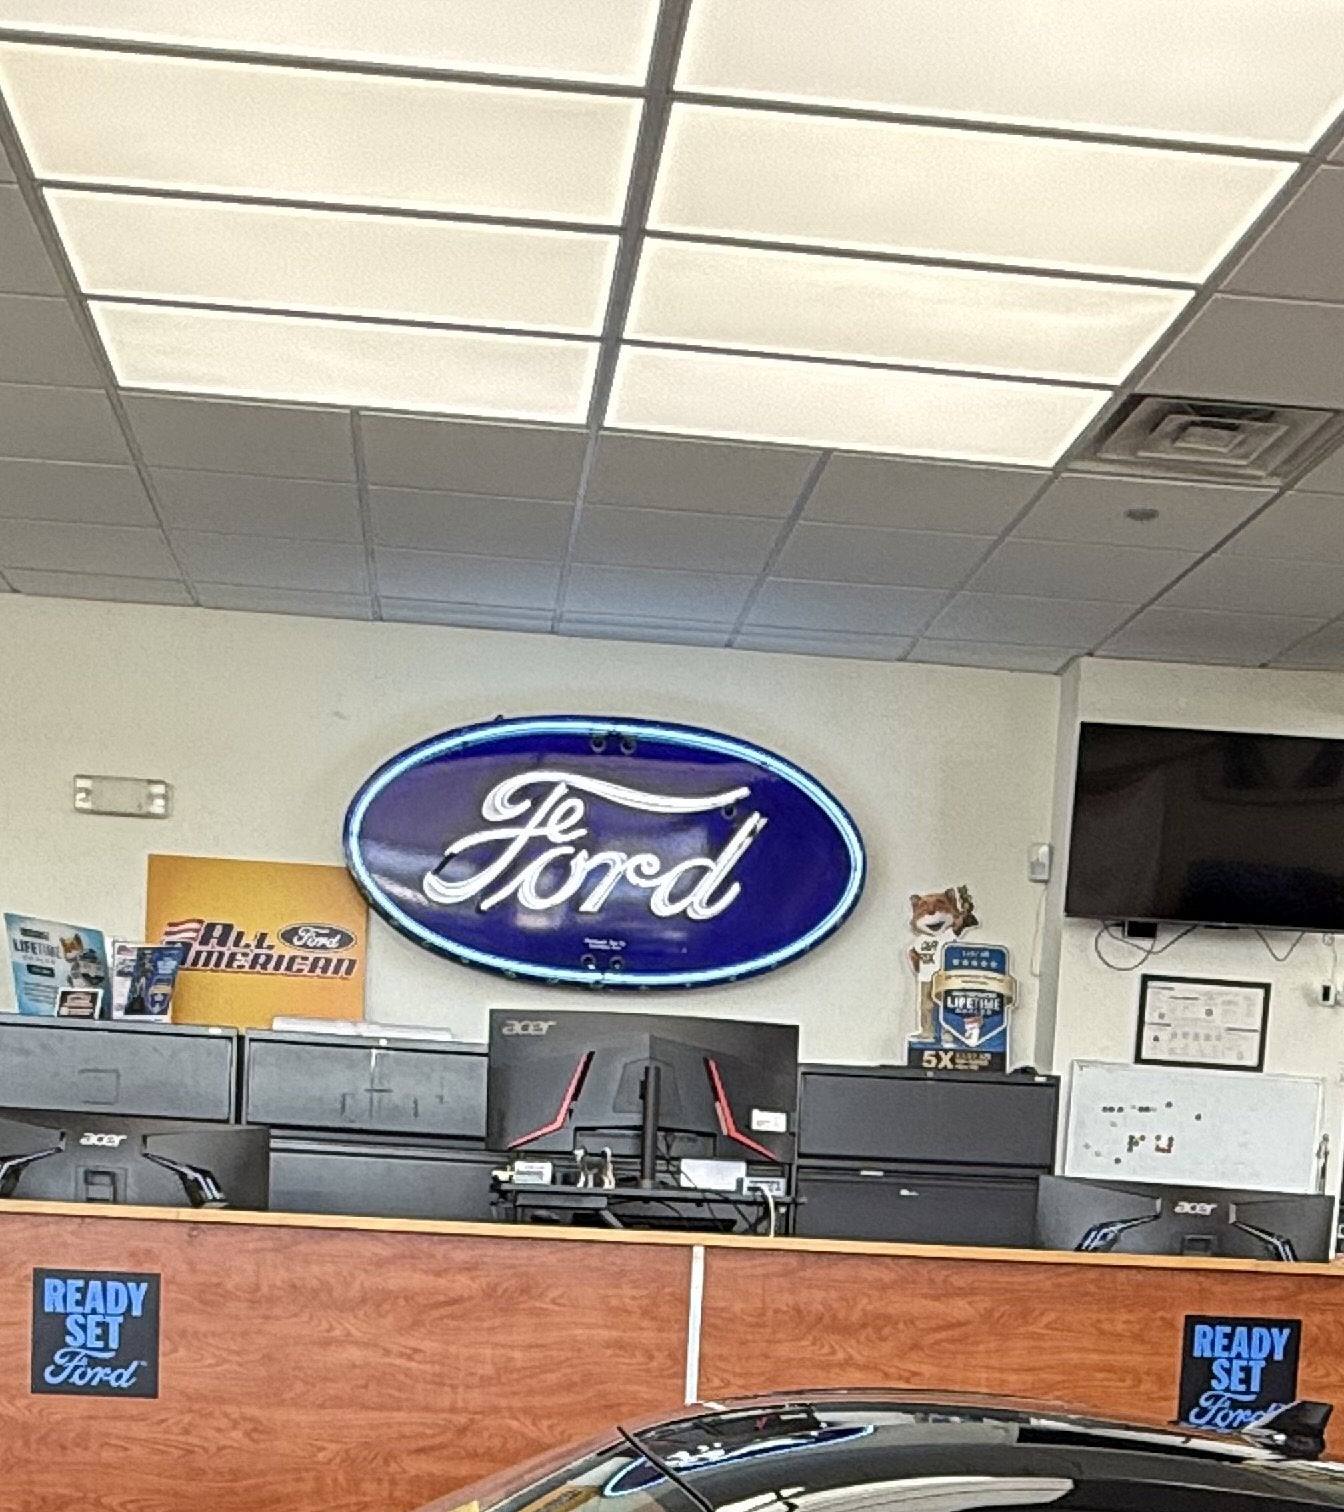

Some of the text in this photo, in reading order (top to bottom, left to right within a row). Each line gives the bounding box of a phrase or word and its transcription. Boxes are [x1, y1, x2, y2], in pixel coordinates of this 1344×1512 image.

[422, 770, 769, 920] Ford
[199, 922, 276, 950] ALL
[292, 926, 342, 949] Ford
[946, 996, 1000, 1010] LIFETIME
[502, 1020, 557, 1036] acer
[922, 1050, 955, 1069] 5X
[79, 1132, 128, 1147] acer
[1174, 1201, 1217, 1215] acer
[44, 1278, 148, 1317] READY
[64, 1314, 124, 1350] SET
[1193, 1324, 1292, 1361] READY
[43, 1347, 138, 1388] Ford
[1210, 1358, 1267, 1391] SET
